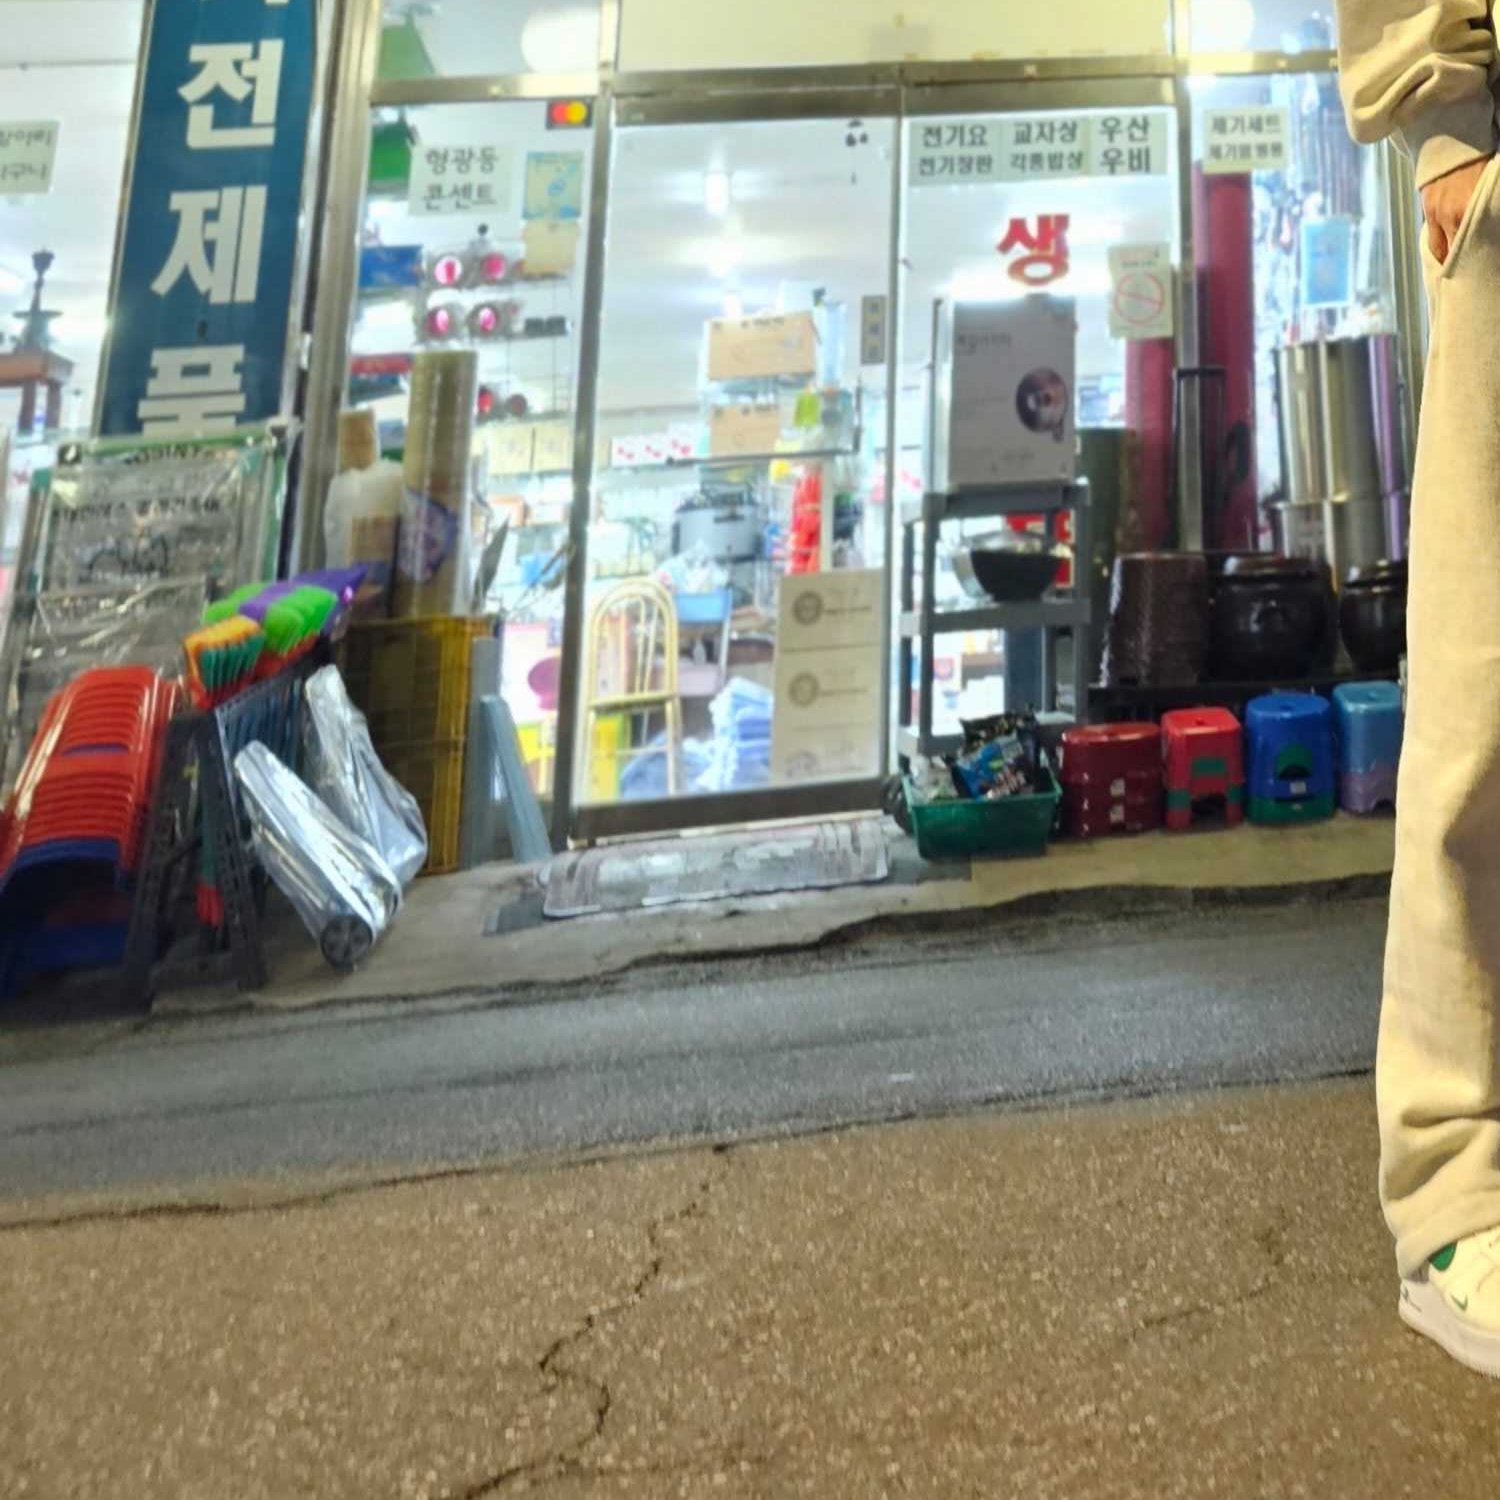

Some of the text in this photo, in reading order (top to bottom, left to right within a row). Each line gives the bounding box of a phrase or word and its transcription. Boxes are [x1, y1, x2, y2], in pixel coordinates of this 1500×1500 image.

[922, 124, 988, 149] 전기요
[1013, 120, 1078, 145] 교자상
[1099, 115, 1150, 143] 우산
[424, 146, 500, 175] 형광등
[1100, 146, 1151, 175] 우비
[422, 182, 497, 211] 콘센트
[997, 213, 1070, 287] 생
